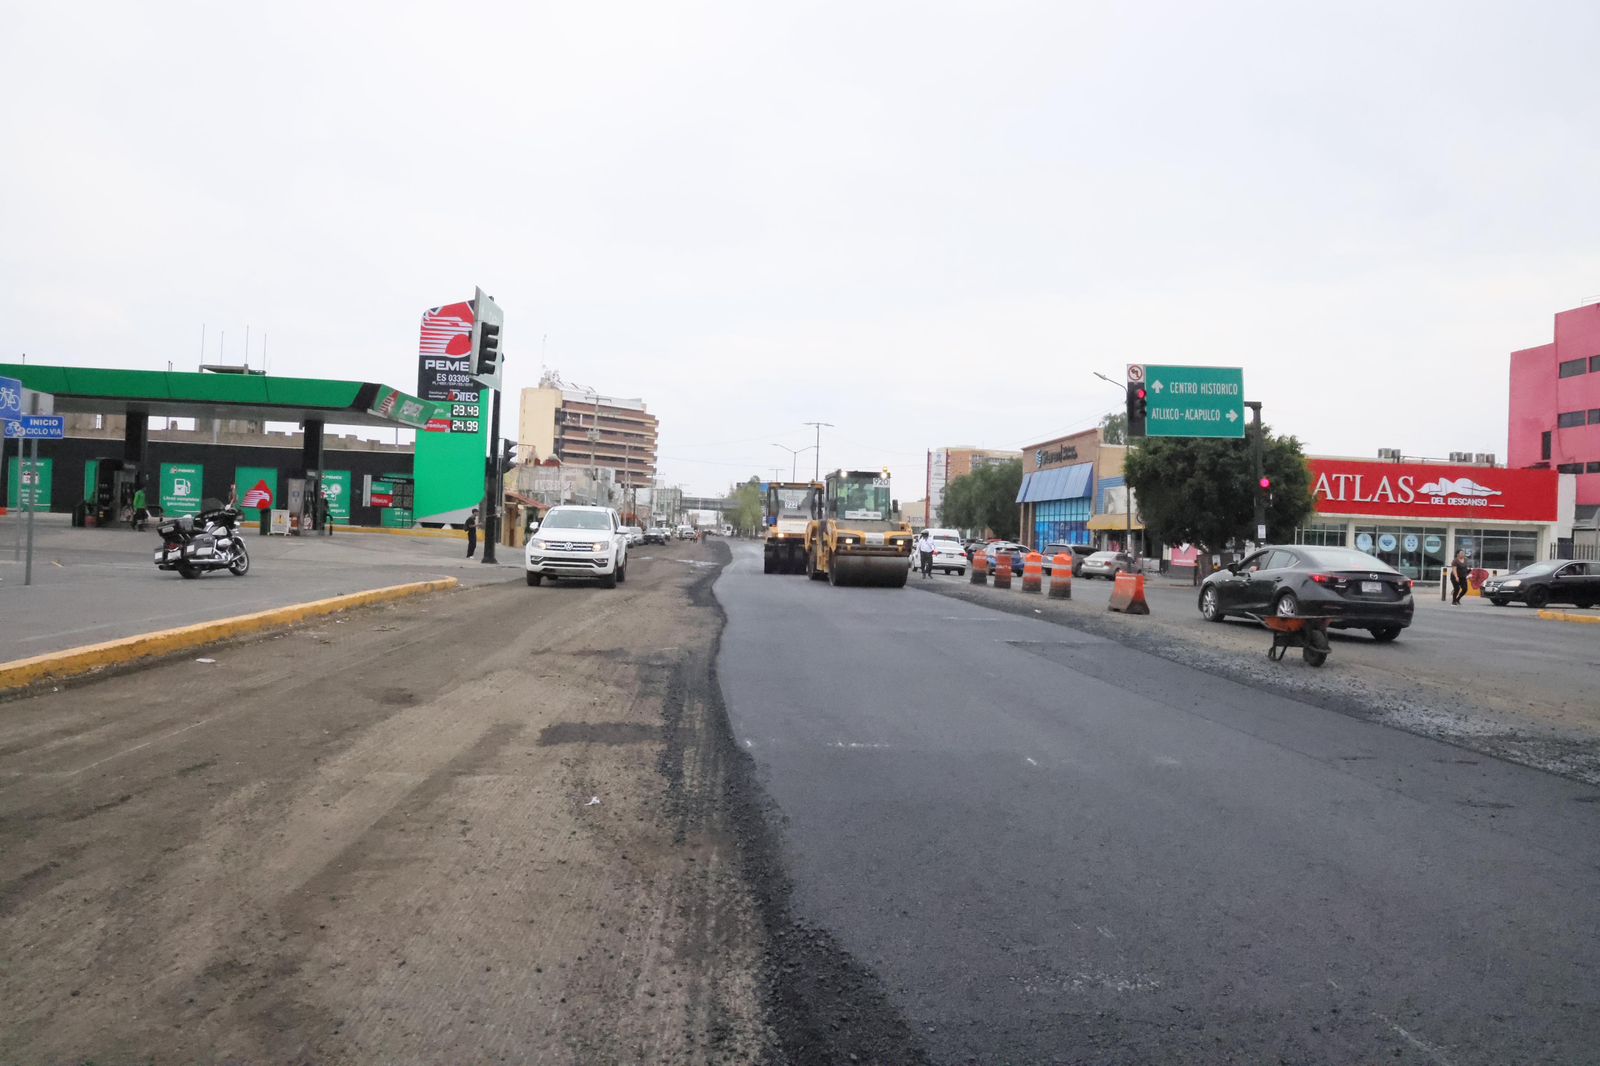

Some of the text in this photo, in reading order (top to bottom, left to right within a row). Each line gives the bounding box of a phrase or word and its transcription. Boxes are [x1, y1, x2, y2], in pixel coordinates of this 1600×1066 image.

[425, 360, 470, 372] PEME
[437, 373, 447, 382] ES
[1170, 383, 1238, 395] CENTRO HISTORICO
[453, 405, 480, 417] 23.43
[1151, 408, 1220, 421] ATLIXCO-ACAPULCO
[452, 420, 479, 432] 24.99
[874, 478, 889, 486] 920
[1312, 472, 1415, 503] ATLAS
[1431, 497, 1488, 506] DEL DESCANSO
